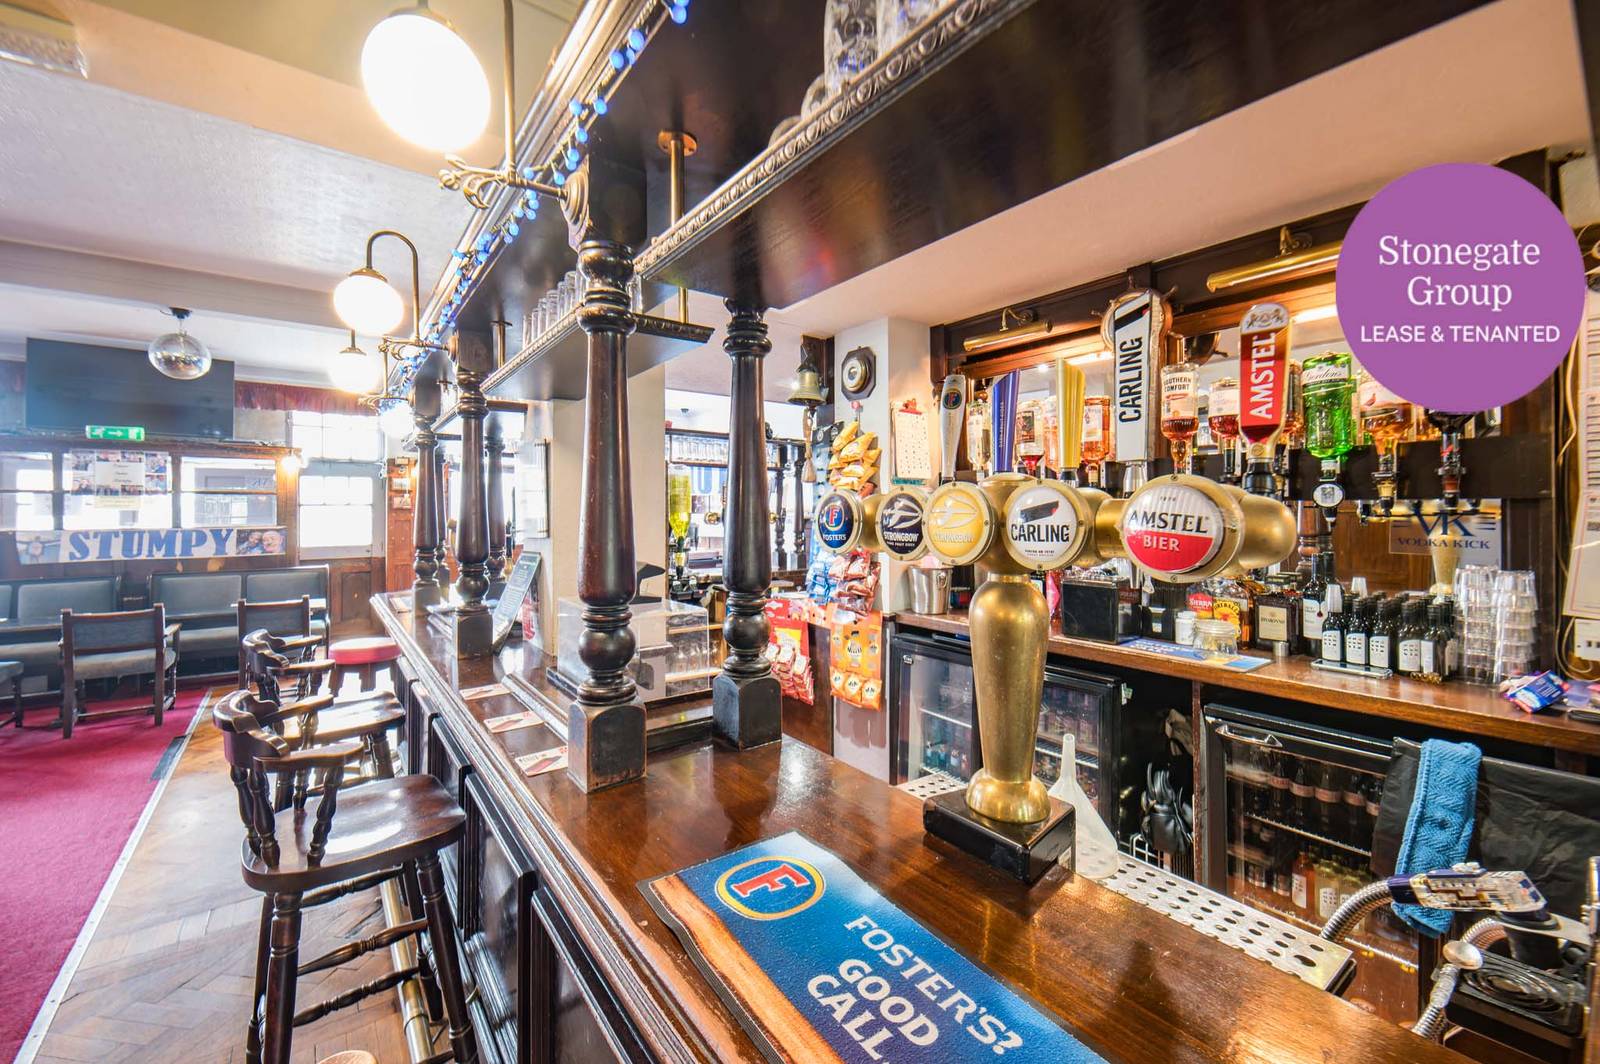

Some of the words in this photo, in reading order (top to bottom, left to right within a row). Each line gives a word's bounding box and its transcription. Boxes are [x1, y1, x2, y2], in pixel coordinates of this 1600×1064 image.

[1118, 336, 1143, 423] CARLING
[1249, 332, 1276, 419] AMSTEL
[884, 531, 919, 542] STRONGBOW
[1011, 523, 1070, 543] CARLING
[1129, 511, 1209, 534] AMSTEL
[69, 527, 234, 561] STUMPY
[1143, 535, 1181, 552] BIER
[1398, 537, 1448, 548] VODKA
[1453, 539, 1490, 550] KICK
[731, 864, 811, 899] F
[838, 958, 939, 1046] GOOD
[844, 915, 1024, 1055] FOSTER'S?
[807, 974, 894, 1063] CALL
